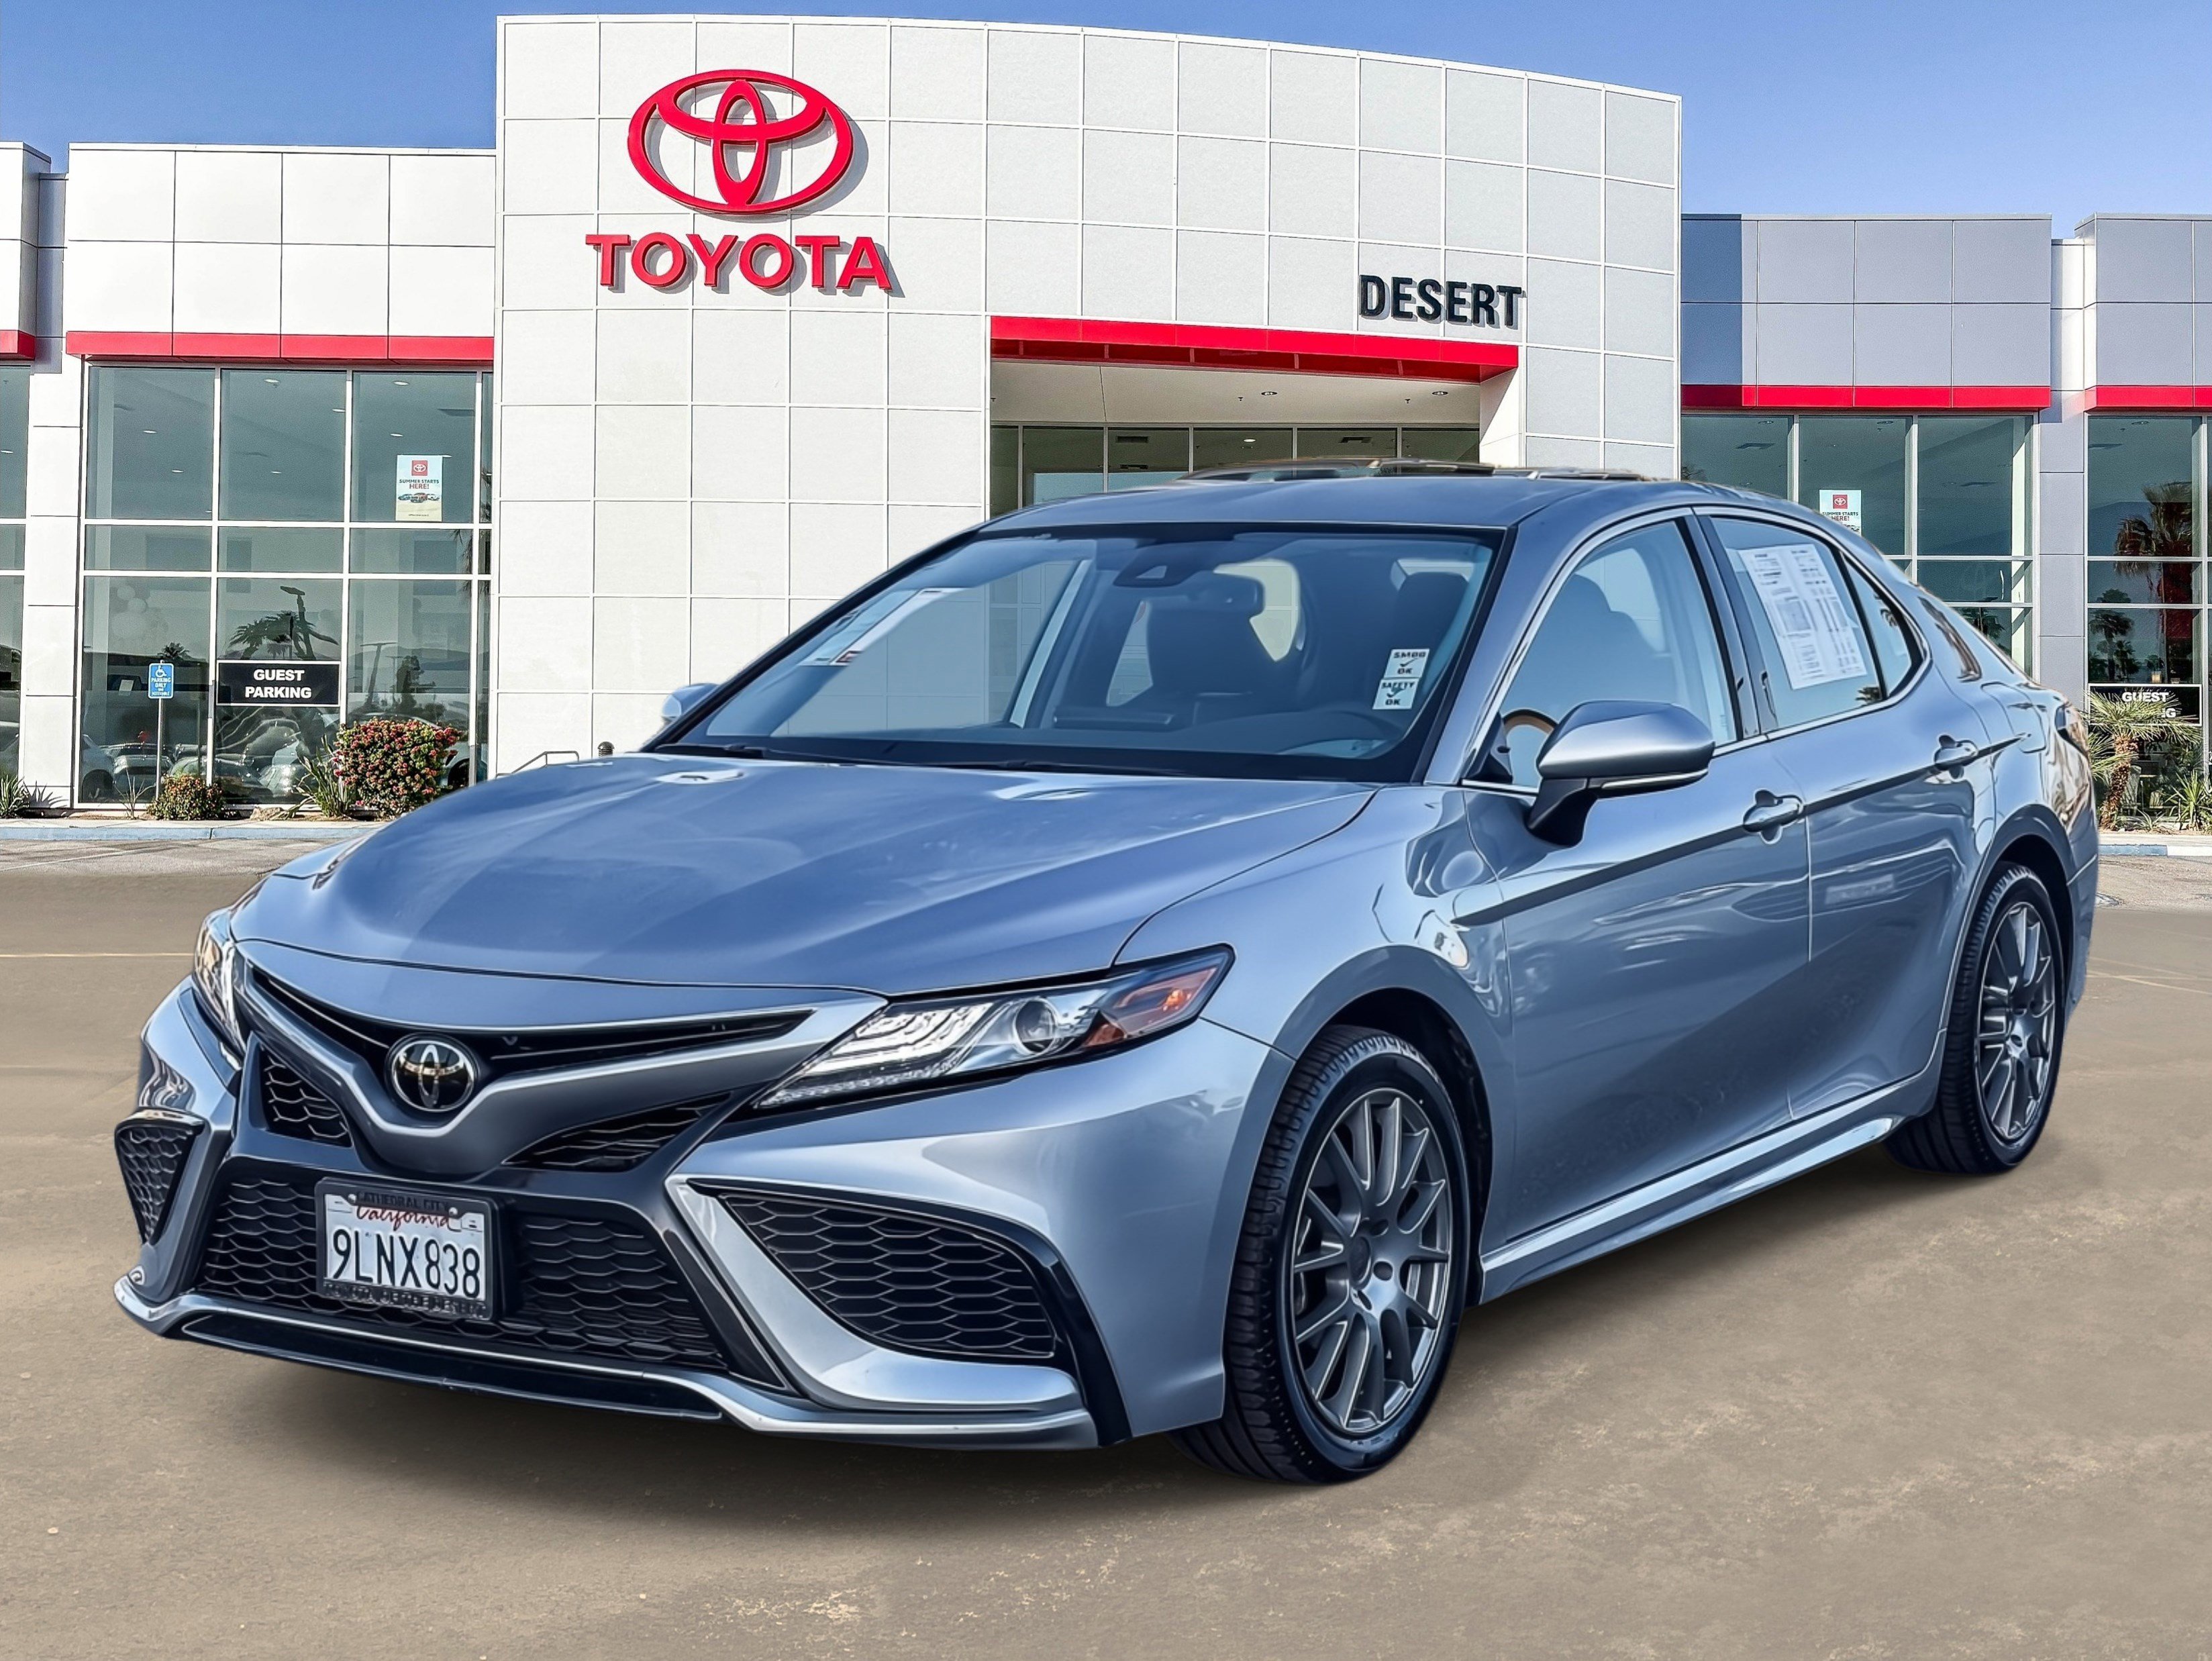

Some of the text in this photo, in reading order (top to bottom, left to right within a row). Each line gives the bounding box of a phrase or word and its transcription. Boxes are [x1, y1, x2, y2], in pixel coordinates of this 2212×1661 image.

[585, 232, 893, 291] TOYOTA
[1358, 274, 1523, 327] DESERT
[253, 668, 305, 682] GUEST
[245, 687, 312, 699] PARKING
[2121, 691, 2170, 702] GUEST
[333, 1229, 481, 1299] 9LNX838
